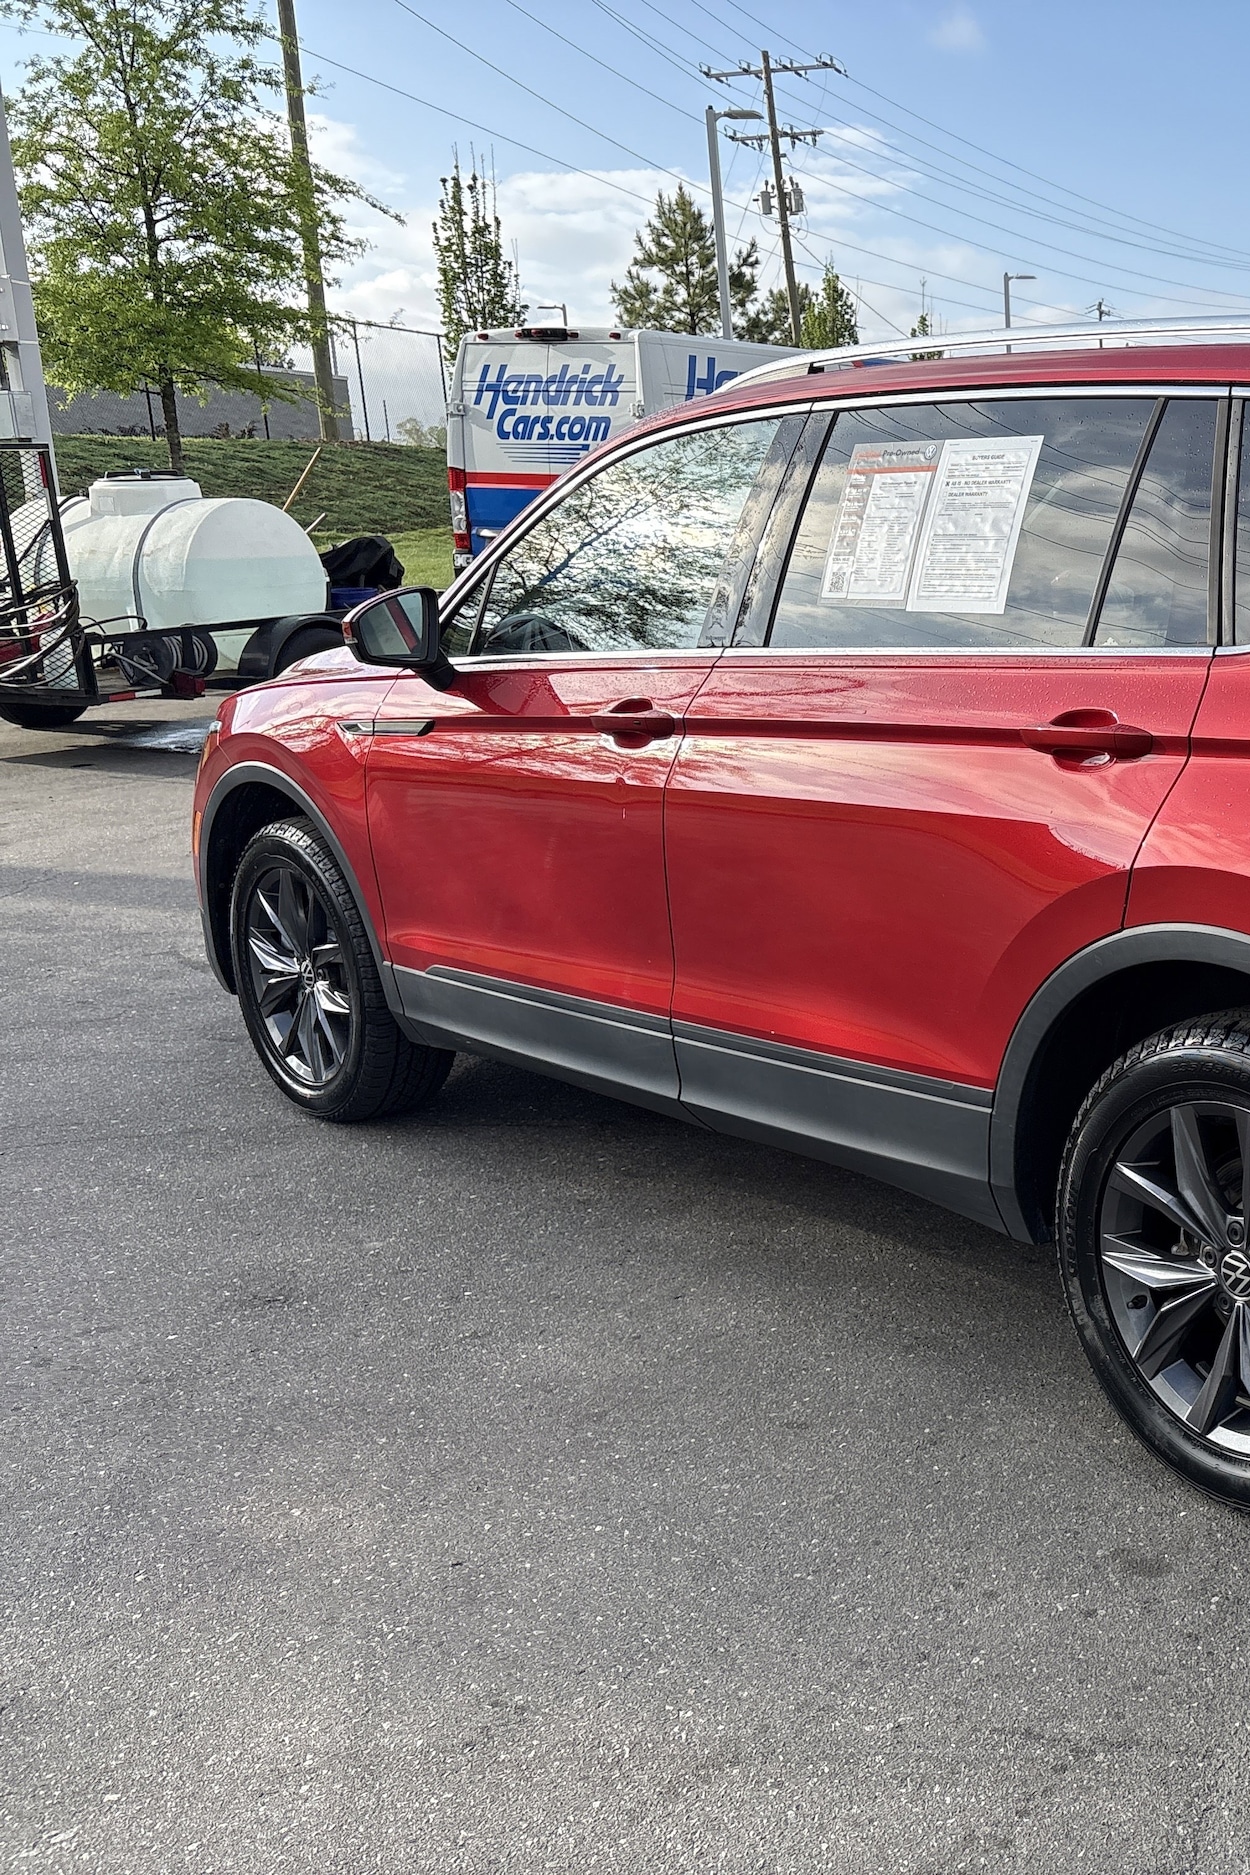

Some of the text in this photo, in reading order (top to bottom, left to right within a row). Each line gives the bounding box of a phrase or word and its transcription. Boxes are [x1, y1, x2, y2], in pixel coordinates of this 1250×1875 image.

[473, 364, 625, 420] Hendrick
[496, 407, 612, 441] Cars.com
[882, 448, 921, 457] Pre-Owned
